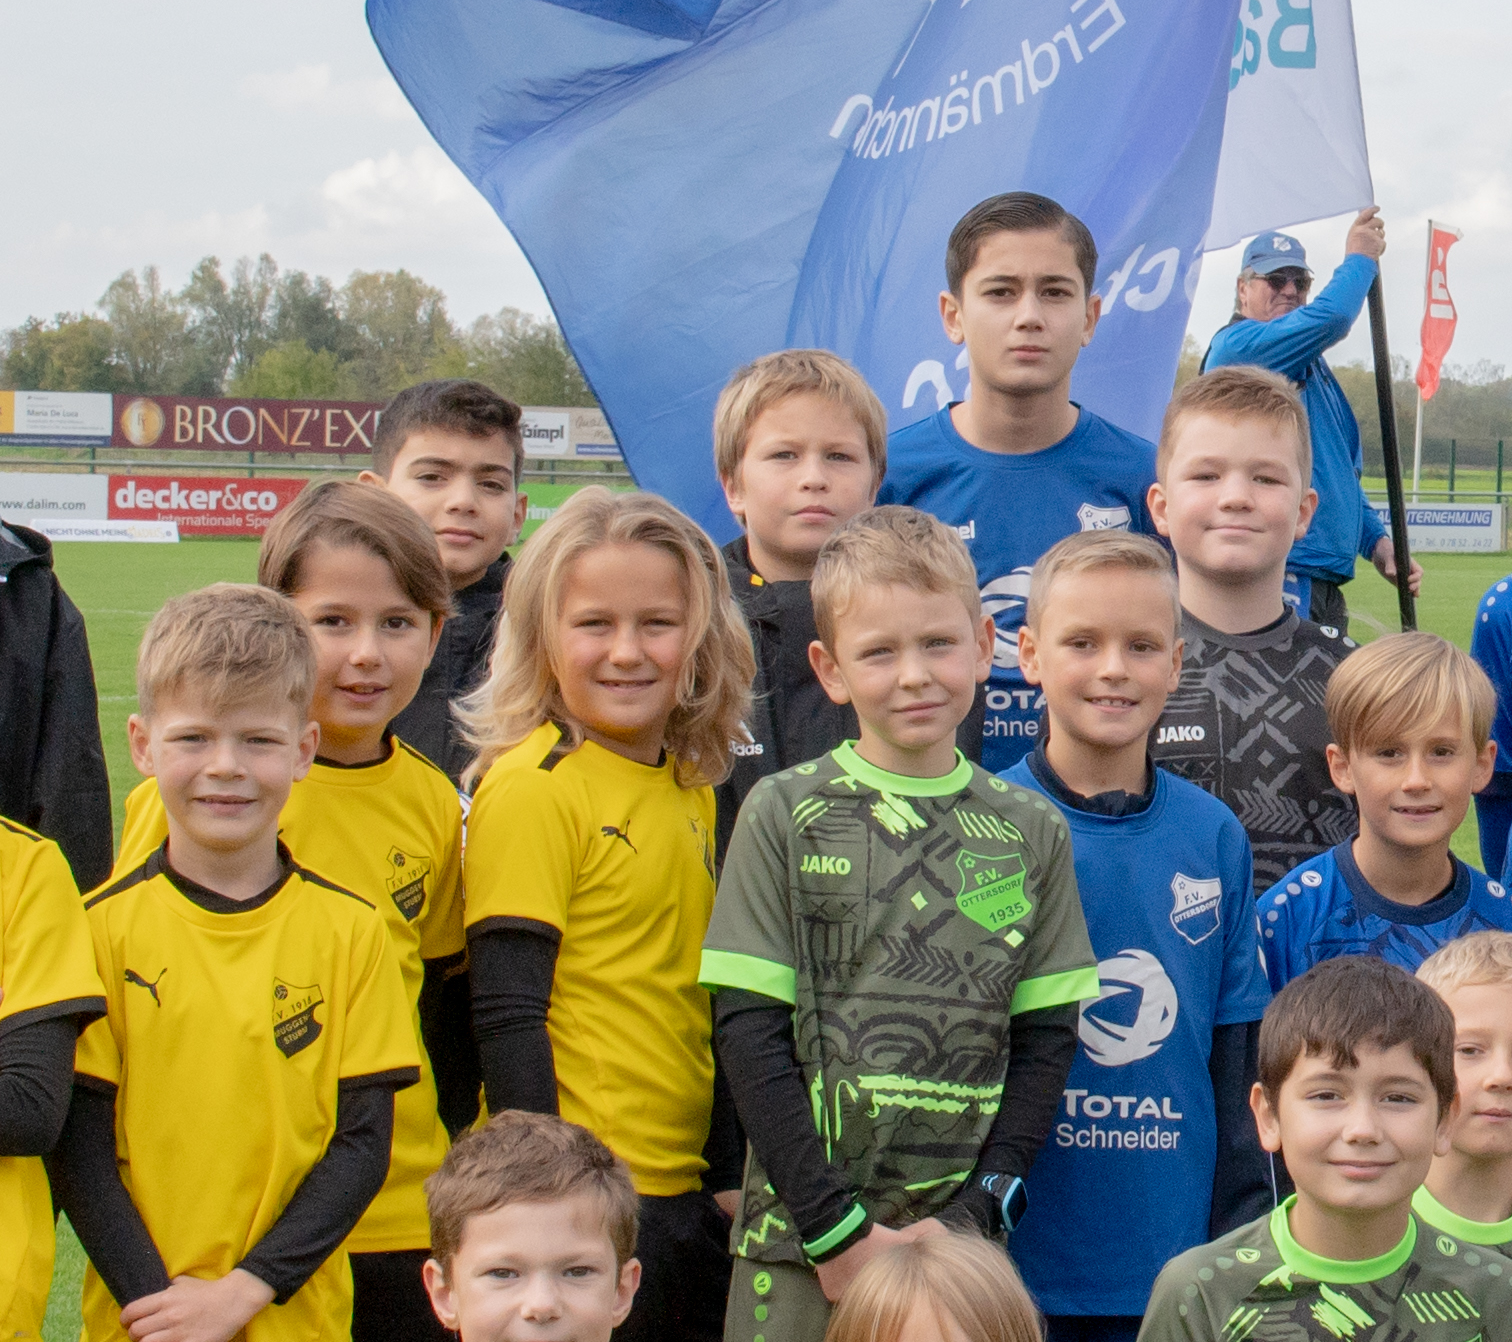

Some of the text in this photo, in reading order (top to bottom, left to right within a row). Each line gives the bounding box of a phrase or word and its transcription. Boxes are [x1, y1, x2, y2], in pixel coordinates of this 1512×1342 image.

[115, 481, 278, 513] decker&co
[1156, 726, 1206, 745] JAKO
[800, 854, 852, 876] JAKO
[974, 867, 1002, 886] F.V.
[960, 877, 1023, 908] OTTERSDORF
[1183, 891, 1204, 905] F.V.
[988, 900, 1025, 924] 1935
[1174, 897, 1219, 924] OTTERSDORF
[1062, 1088, 1183, 1120] TOTAL
[1055, 1122, 1181, 1150] Schneider
